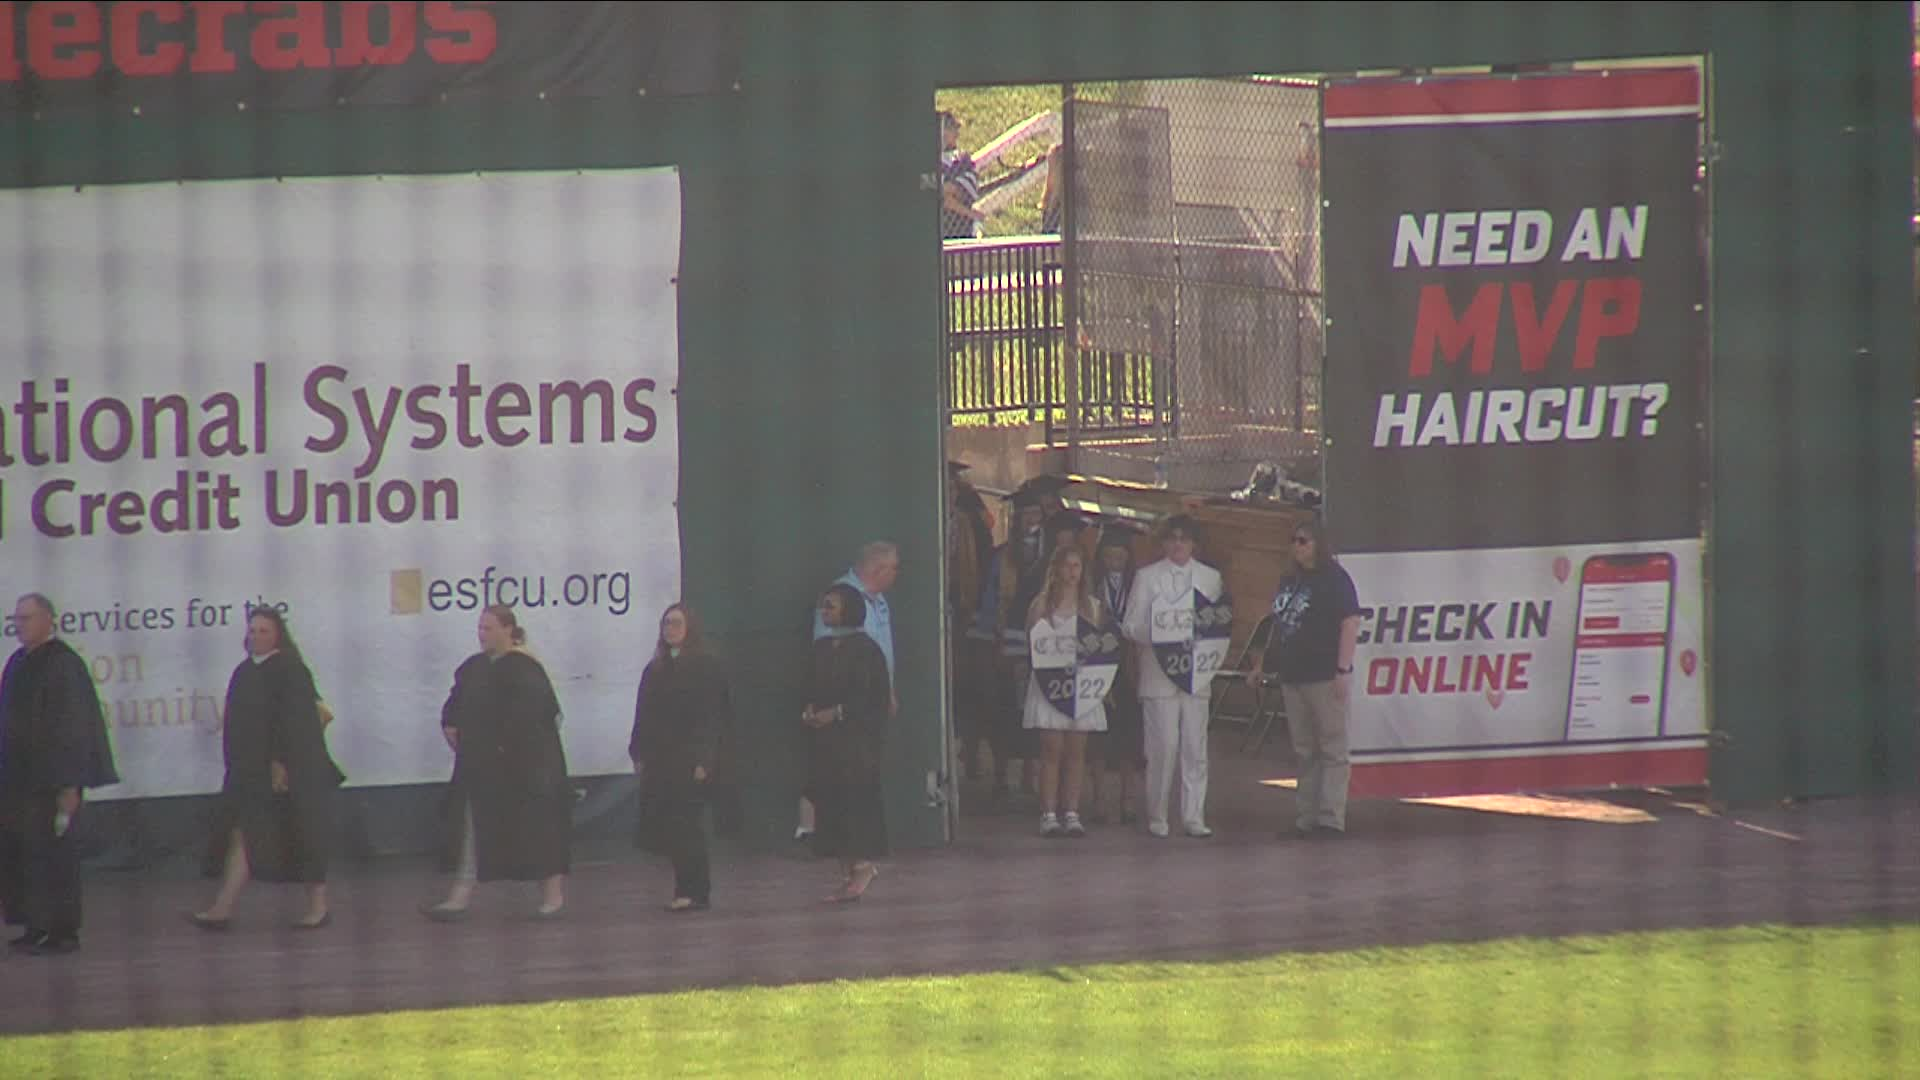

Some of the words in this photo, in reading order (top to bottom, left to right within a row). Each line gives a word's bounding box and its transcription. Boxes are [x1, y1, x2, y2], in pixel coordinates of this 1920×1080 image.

[0, 1, 498, 82] ecrabs
[1392, 209, 1553, 268] NEED
[1560, 205, 1649, 262] AN
[1408, 277, 1643, 378] MVP
[0, 362, 267, 467] tional
[304, 364, 657, 479] Systems
[1373, 382, 1670, 448] HAIRCUT?
[31, 470, 240, 538] Credit
[265, 469, 459, 527] Union
[187, 598, 233, 628] for
[428, 566, 630, 615] esfcu.org
[1506, 600, 1553, 639] IN
[1166, 650, 1219, 675] 2022
[1366, 652, 1533, 695] ONLINE
[106, 687, 223, 735] unity
[1047, 677, 1106, 701] 2022
